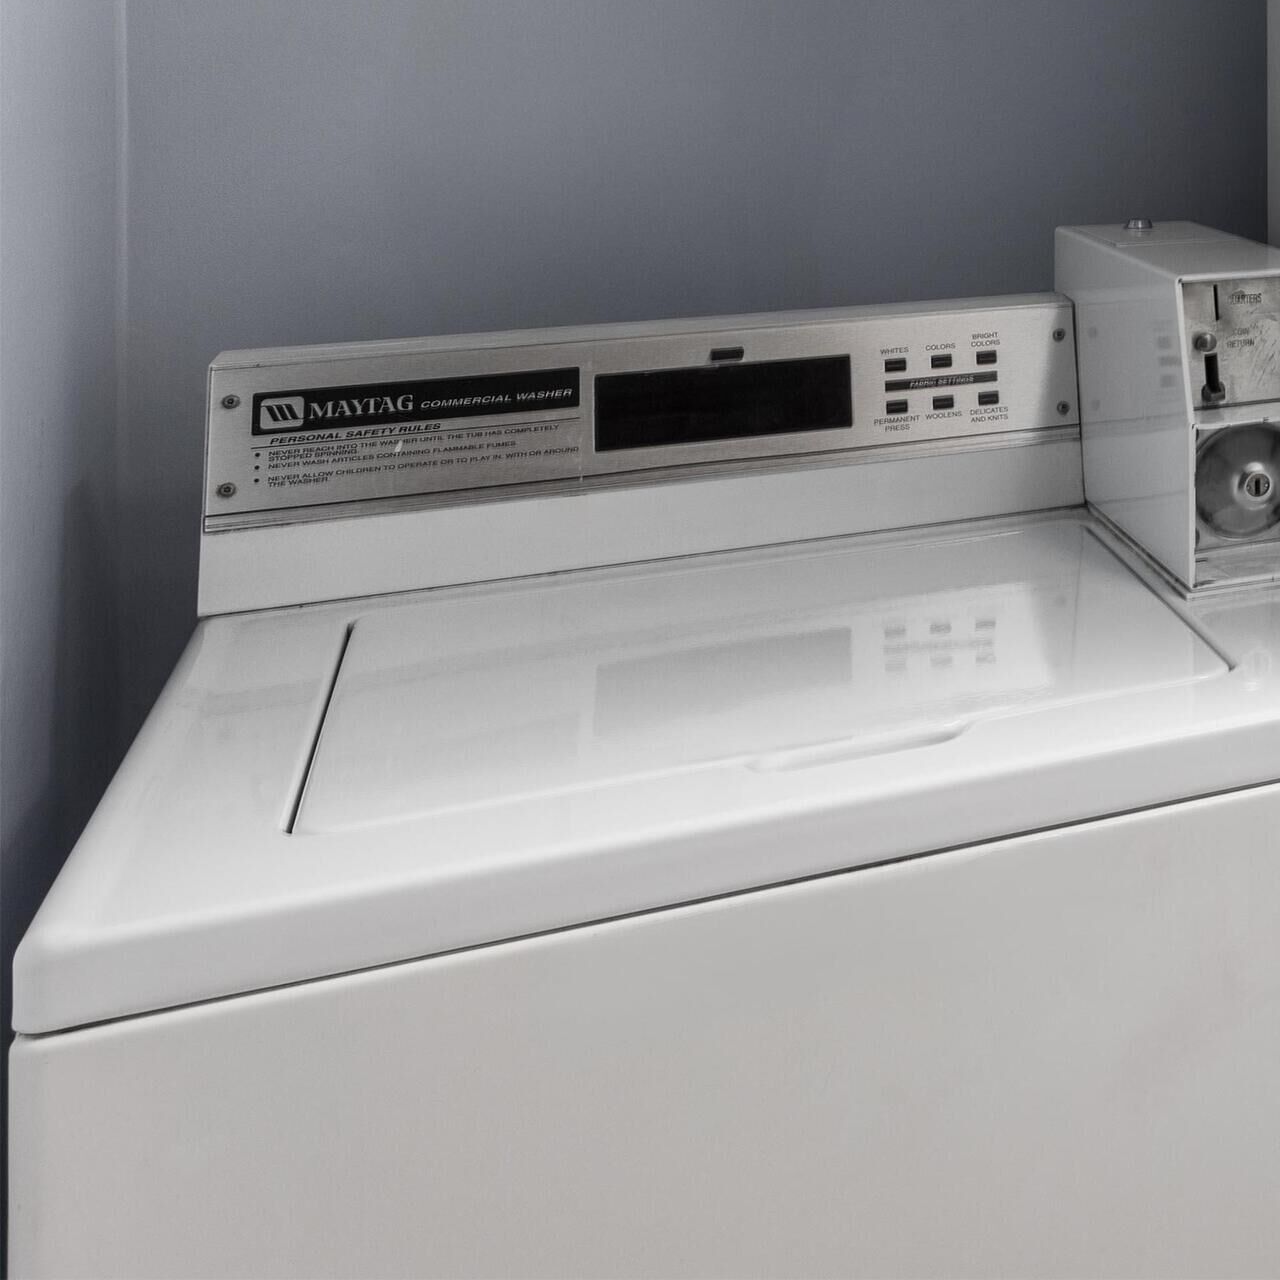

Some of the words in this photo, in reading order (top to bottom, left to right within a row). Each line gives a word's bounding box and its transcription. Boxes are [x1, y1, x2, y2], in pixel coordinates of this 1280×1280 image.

[971, 332, 998, 340] BRIGHT
[925, 343, 956, 351] COLORS
[970, 339, 1001, 348] COLORS
[880, 346, 909, 355] WHITES
[420, 394, 512, 409] COMMERCIAL
[516, 388, 574, 401] WASHER
[309, 394, 414, 419] MAYTAG
[970, 406, 1009, 416] DELICATES
[925, 411, 963, 420] WOOLENS
[970, 416, 987, 424] AND
[874, 415, 921, 426] PERMANENT
[885, 424, 911, 432] PRESS
[270, 431, 342, 445] PERSONAL
[345, 426, 397, 438] SAFETY
[398, 422, 441, 433] RULES
[268, 447, 300, 457] NEVER
[360, 440, 378, 448] THE
[268, 461, 300, 470] NEVER
[268, 474, 300, 483] NEVER
[302, 470, 334, 479] ALLOW
